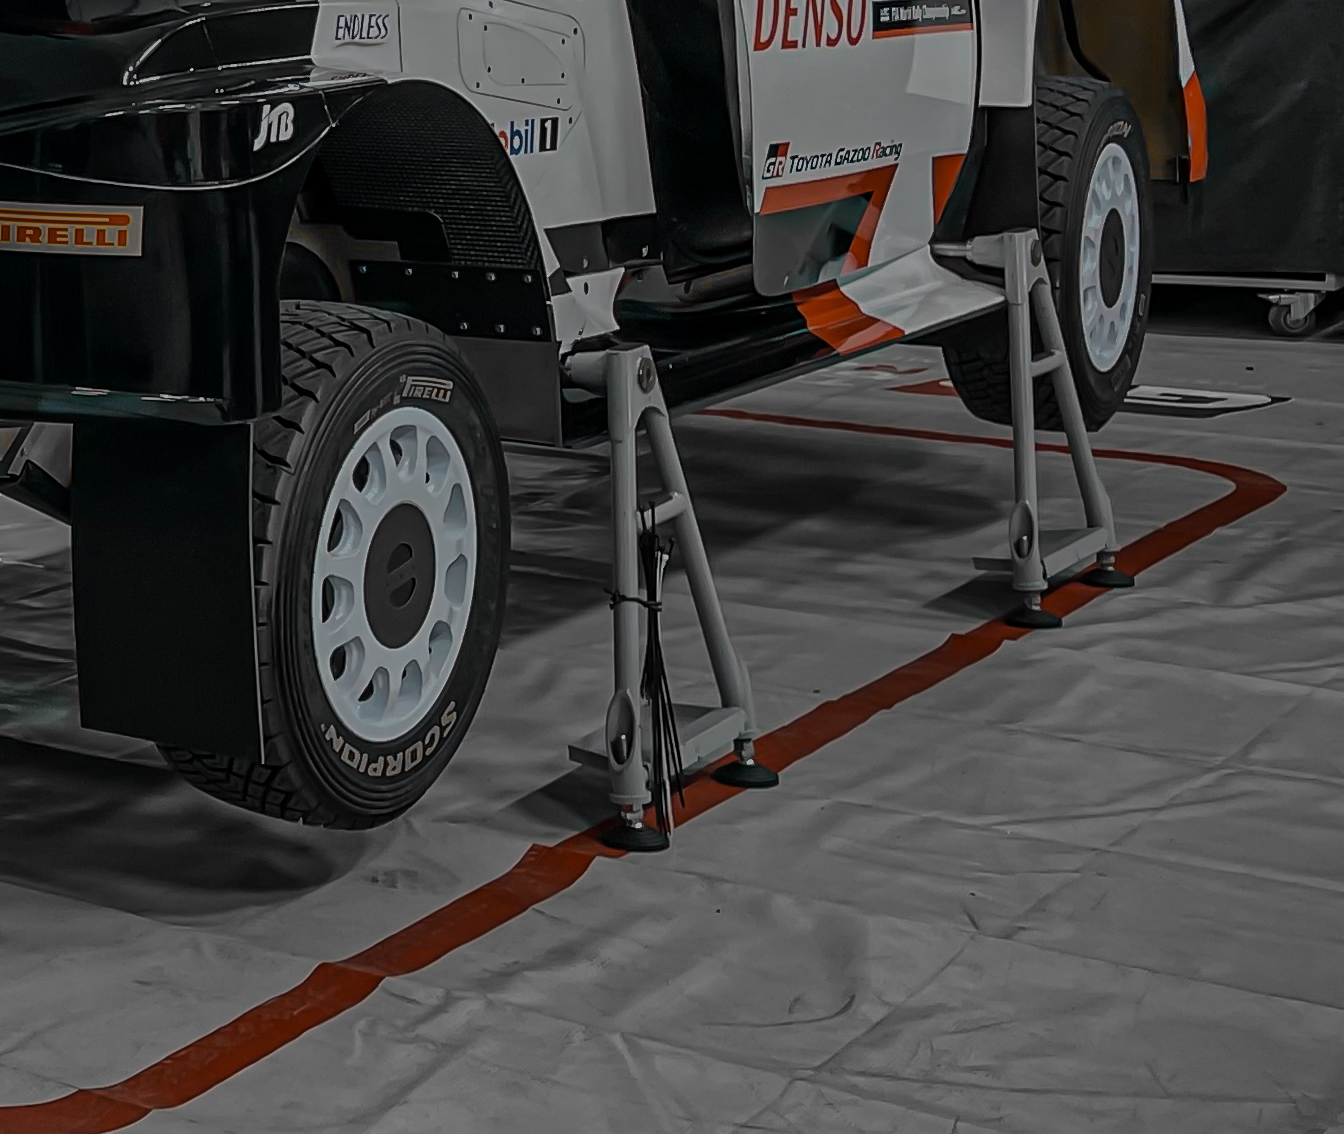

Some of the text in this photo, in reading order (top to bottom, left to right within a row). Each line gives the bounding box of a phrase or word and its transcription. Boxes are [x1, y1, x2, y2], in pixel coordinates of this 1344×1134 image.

[334, 13, 390, 41] ENDLESS
[252, 100, 297, 153] JTB
[497, 118, 557, 156] obil 1
[763, 139, 904, 179] GR TOYOTA GAZOO Racing
[402, 375, 455, 403] PIRELLI
[324, 700, 459, 778] SCORPION
